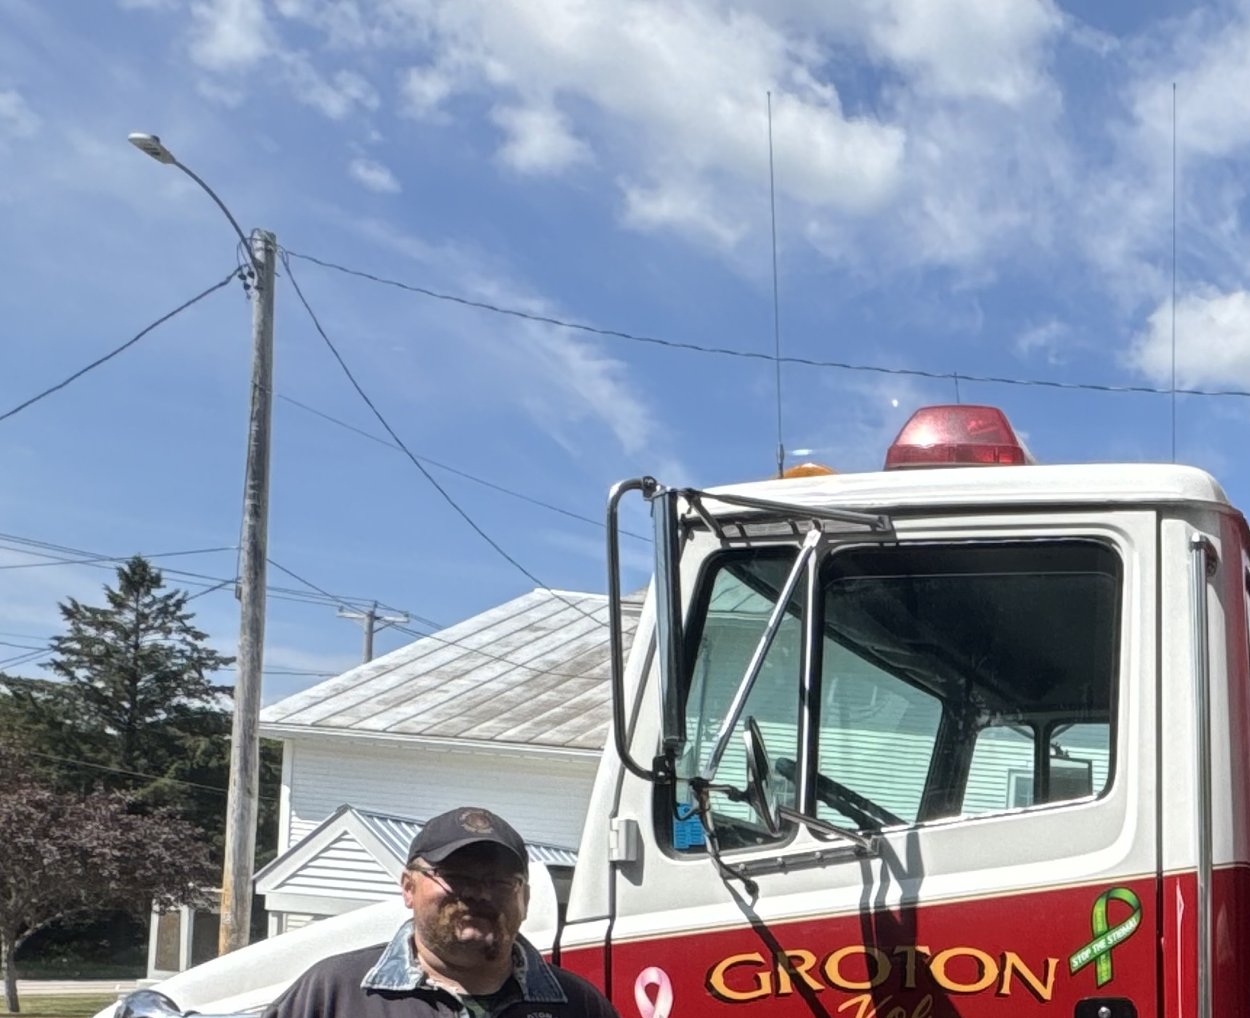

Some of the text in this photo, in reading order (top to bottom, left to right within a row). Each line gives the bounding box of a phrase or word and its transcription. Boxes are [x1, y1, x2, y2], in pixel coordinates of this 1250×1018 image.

[706, 945, 1060, 1002] GROTON
[1072, 948, 1092, 967] STOP
[1092, 938, 1106, 954] THE
